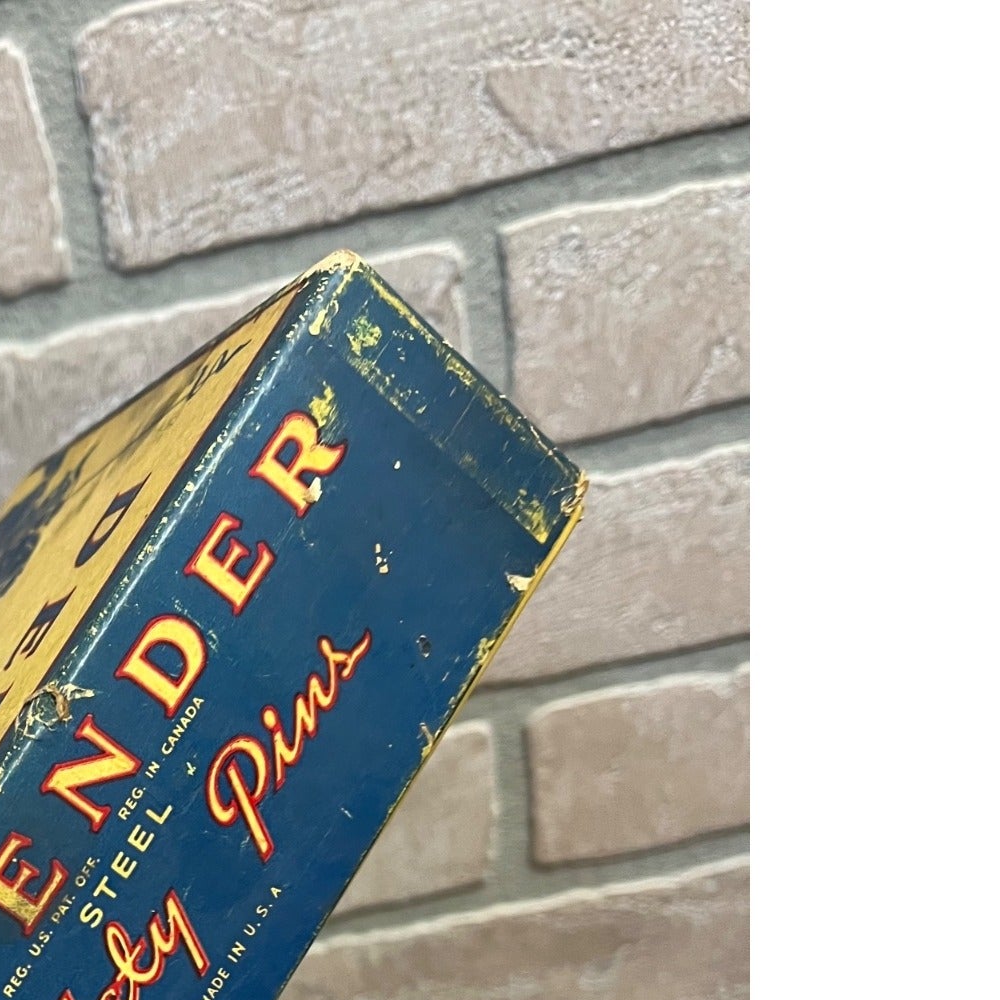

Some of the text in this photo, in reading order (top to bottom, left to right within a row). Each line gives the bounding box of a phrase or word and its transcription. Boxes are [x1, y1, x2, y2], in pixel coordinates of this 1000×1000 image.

[206, 629, 372, 863] Pins
[3, 696, 204, 997] REG. U.S. PAT. OFF. REG. IN CANADA
[80, 805, 173, 928] STEEL
[227, 941, 246, 963] IN
